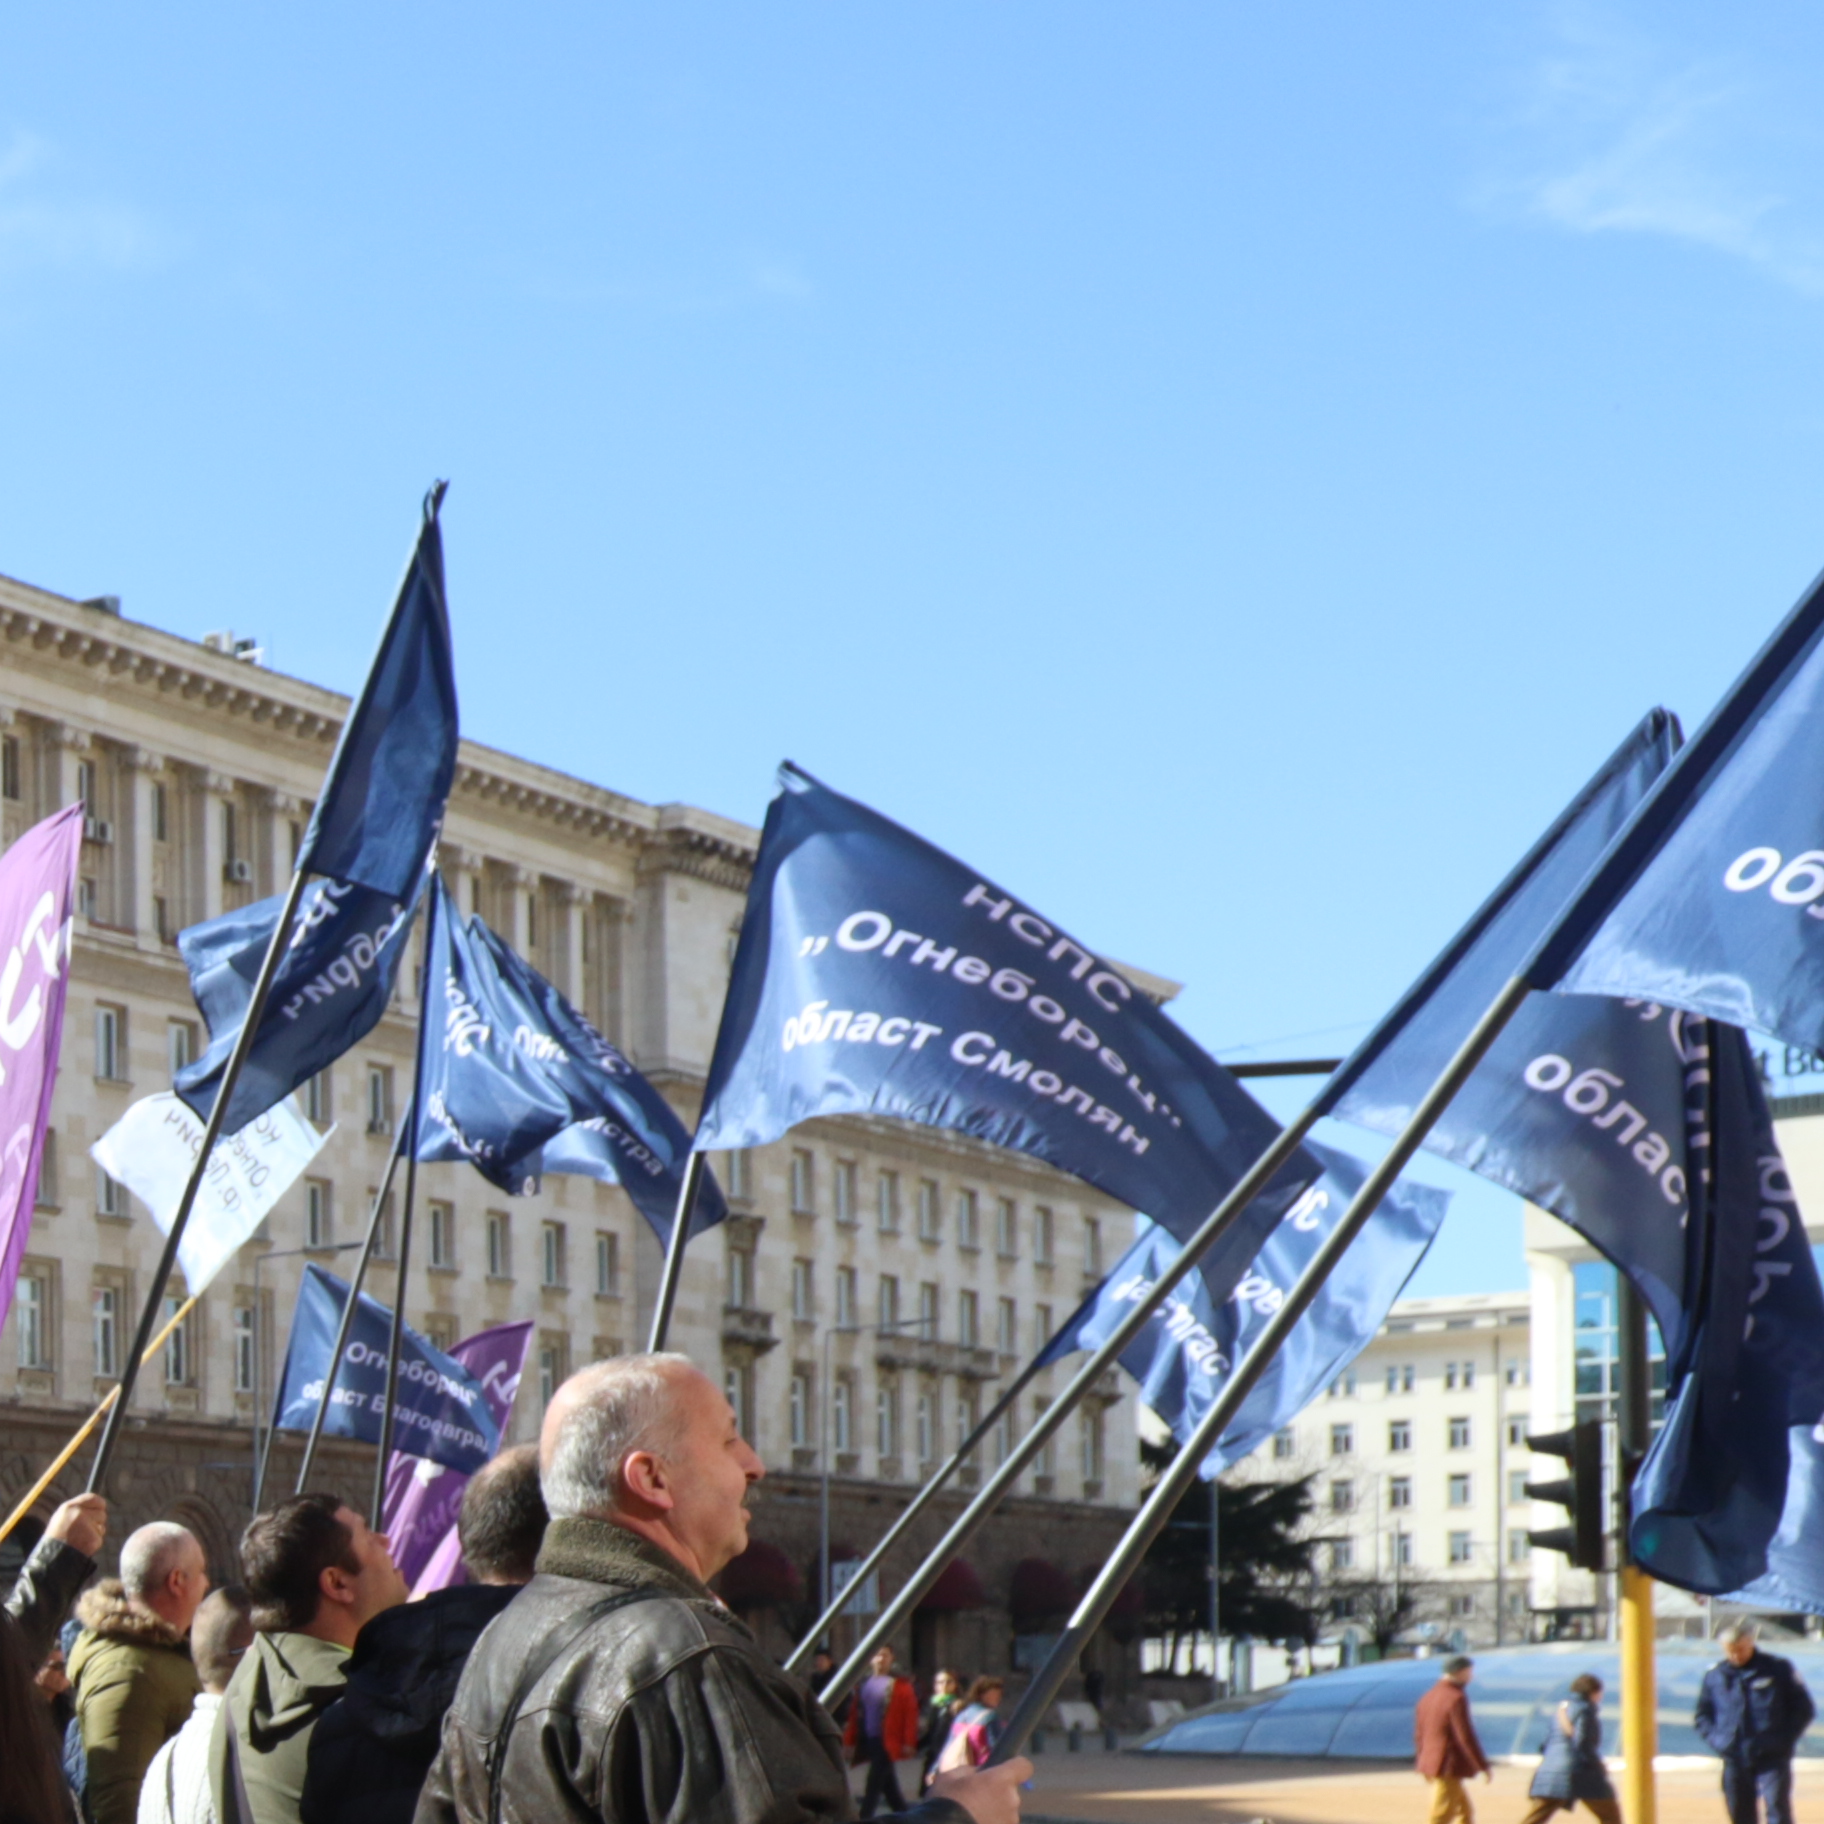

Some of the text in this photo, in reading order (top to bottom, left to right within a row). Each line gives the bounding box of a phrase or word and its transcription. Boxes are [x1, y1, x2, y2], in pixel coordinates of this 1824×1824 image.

[962, 883, 1133, 1013] НСПС
[782, 1000, 1151, 1156] област Смолян
[1523, 1053, 1689, 1218] облас
